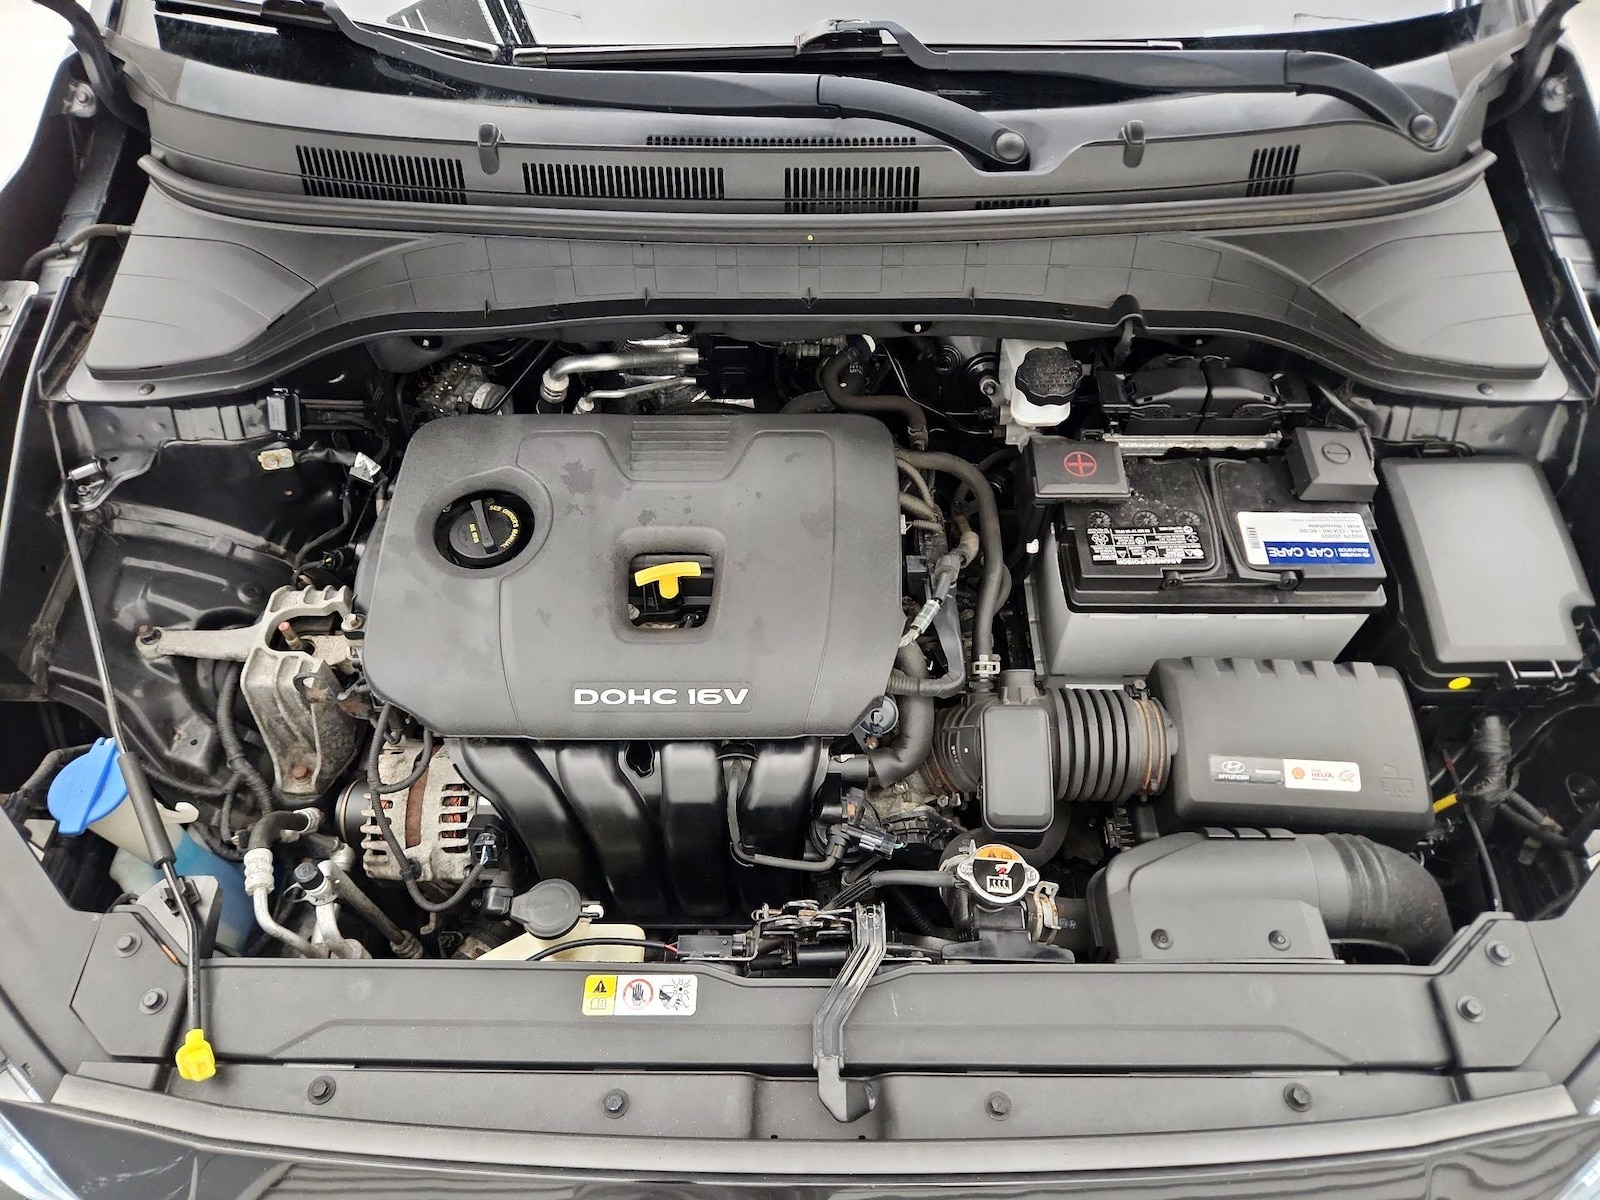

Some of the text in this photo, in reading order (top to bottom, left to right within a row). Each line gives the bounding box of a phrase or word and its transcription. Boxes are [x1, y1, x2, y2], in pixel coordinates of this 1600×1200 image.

[1267, 547, 1334, 558] CAR CARE
[574, 688, 749, 705] DOHC 16V
